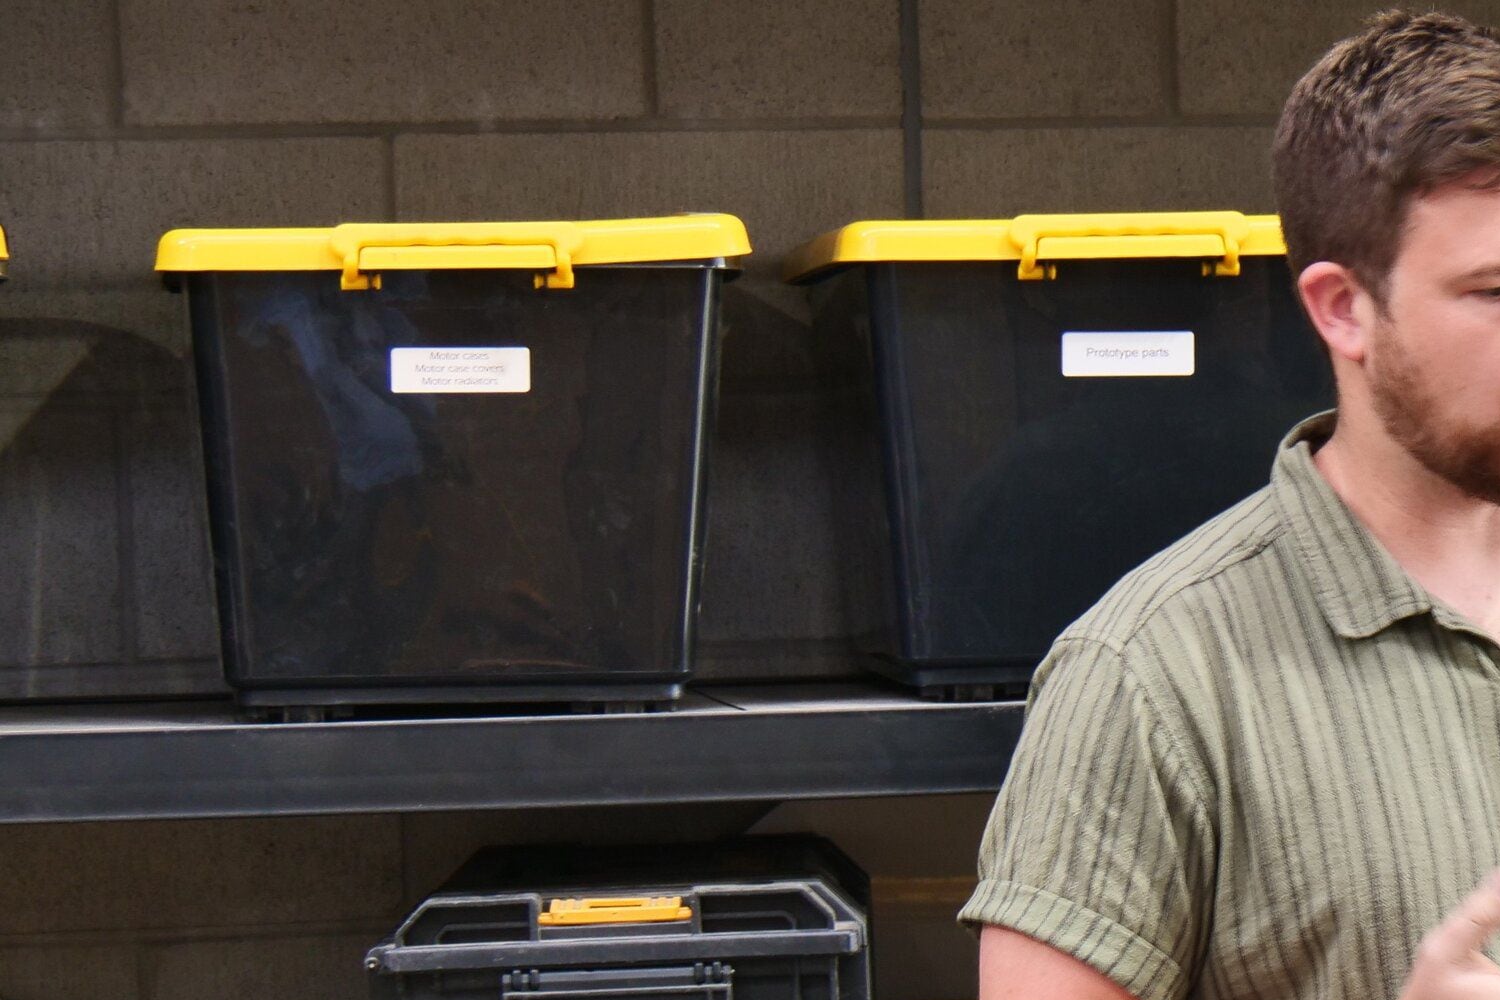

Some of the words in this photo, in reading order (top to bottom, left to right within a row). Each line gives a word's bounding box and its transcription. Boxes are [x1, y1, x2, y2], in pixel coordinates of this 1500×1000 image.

[1086, 347, 1139, 360] Prototype
[1142, 348, 1170, 359] parts
[415, 364, 445, 373] Motor
[421, 377, 451, 386] Motor
